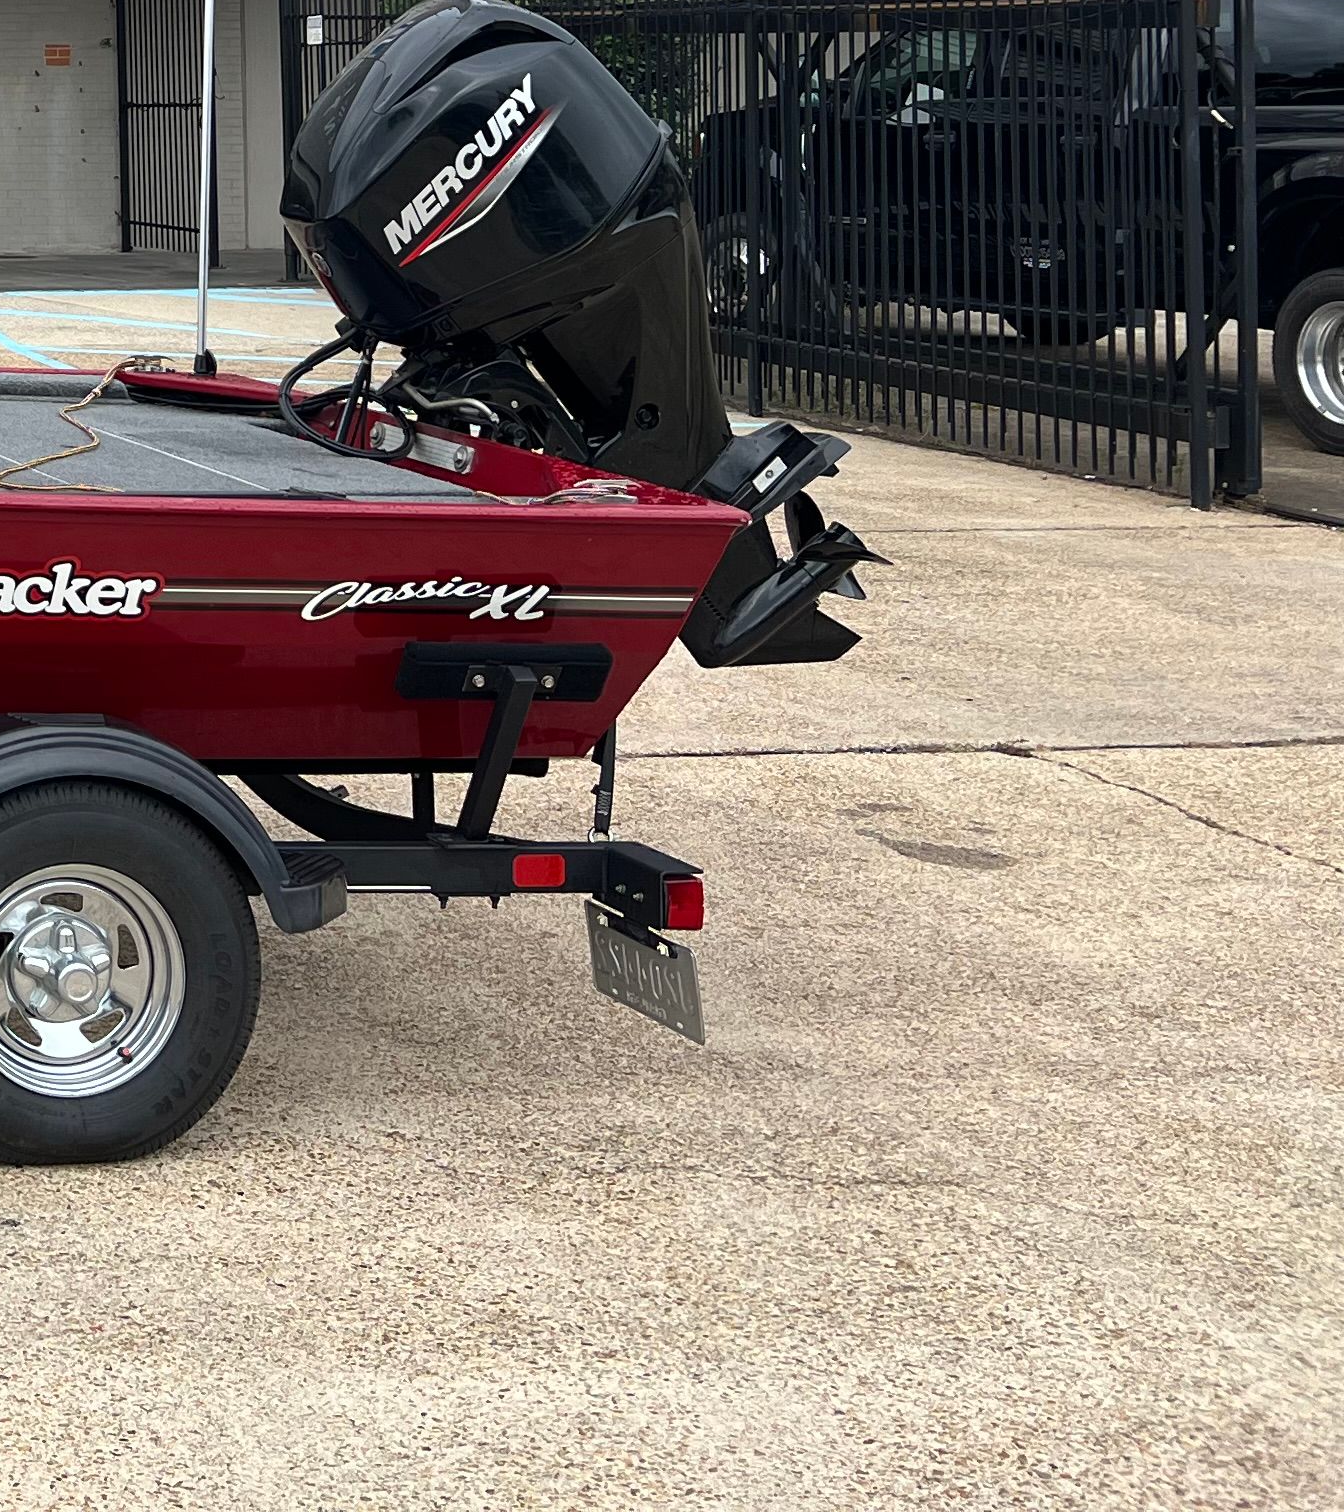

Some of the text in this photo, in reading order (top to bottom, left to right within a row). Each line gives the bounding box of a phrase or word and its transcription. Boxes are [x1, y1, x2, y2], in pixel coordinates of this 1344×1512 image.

[383, 72, 536, 255] MERCURY
[301, 576, 550, 621] Classic XL
